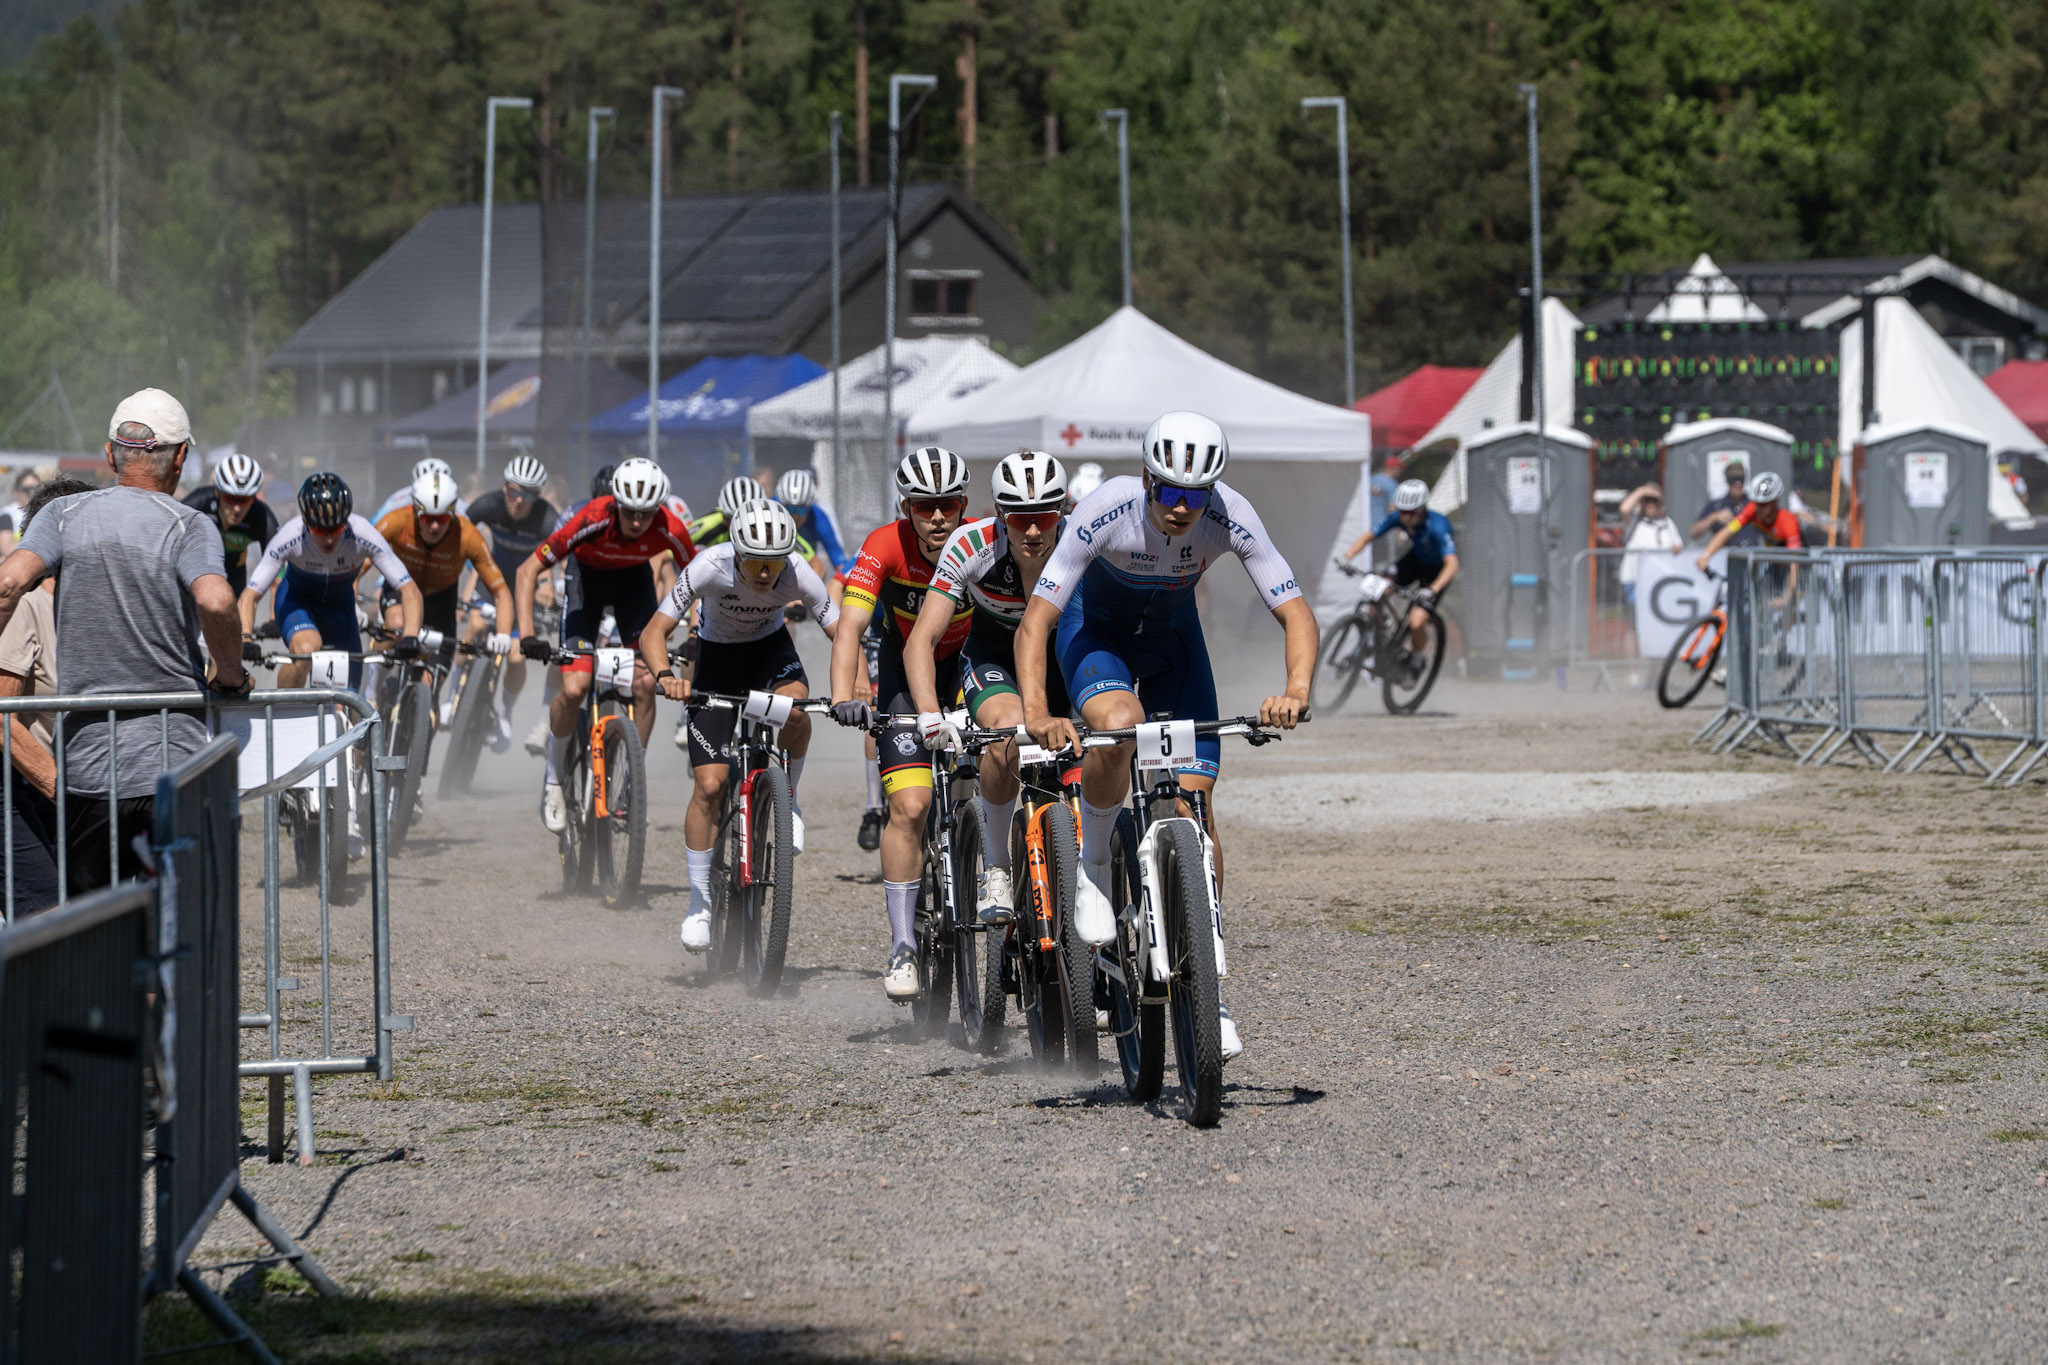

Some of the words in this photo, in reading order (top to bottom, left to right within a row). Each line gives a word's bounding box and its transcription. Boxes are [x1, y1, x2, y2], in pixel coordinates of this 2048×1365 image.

[1091, 498, 1136, 533] SCOTT
[1207, 510, 1255, 541] SCOTT
[327, 661, 333, 680] 4
[613, 656, 620, 675] 3
[764, 695, 774, 716] 1
[1160, 725, 1172, 756] 5
